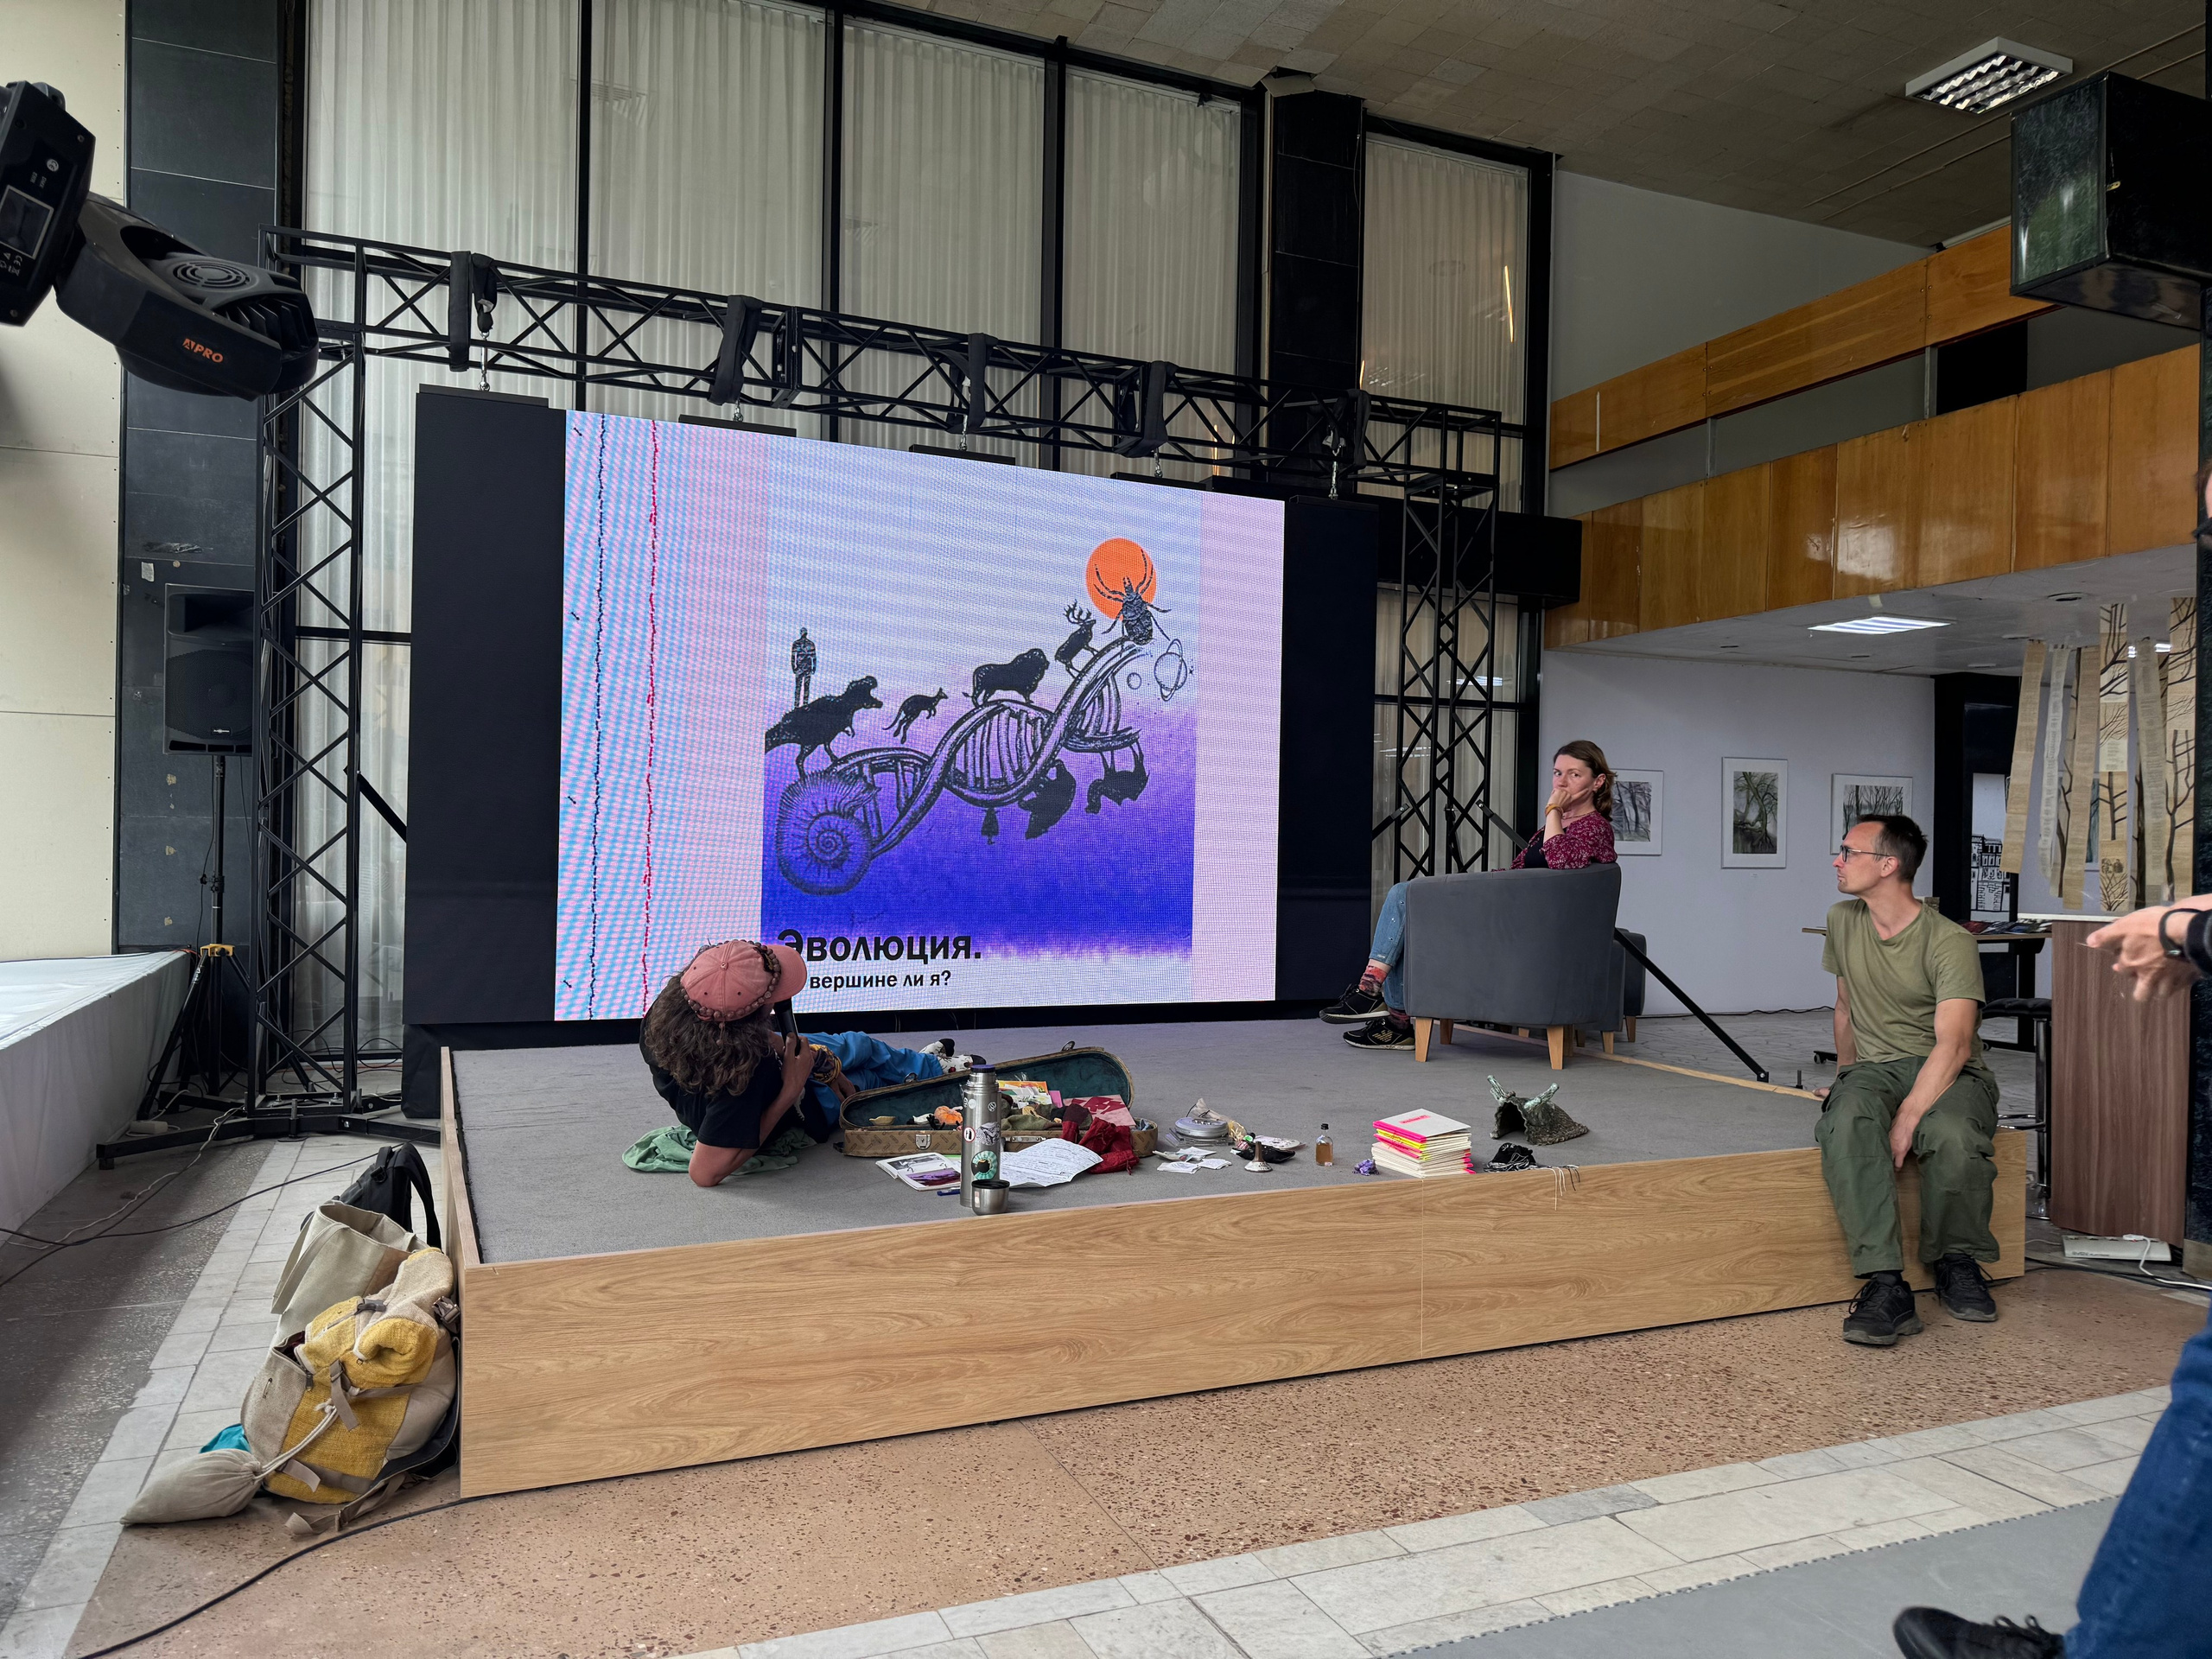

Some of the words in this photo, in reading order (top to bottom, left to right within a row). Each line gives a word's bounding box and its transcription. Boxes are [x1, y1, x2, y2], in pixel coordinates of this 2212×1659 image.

[778, 929, 982, 964] Эволюция.
[810, 974, 897, 992] вершине
[903, 975, 924, 987] ли
[931, 970, 951, 986] я?
